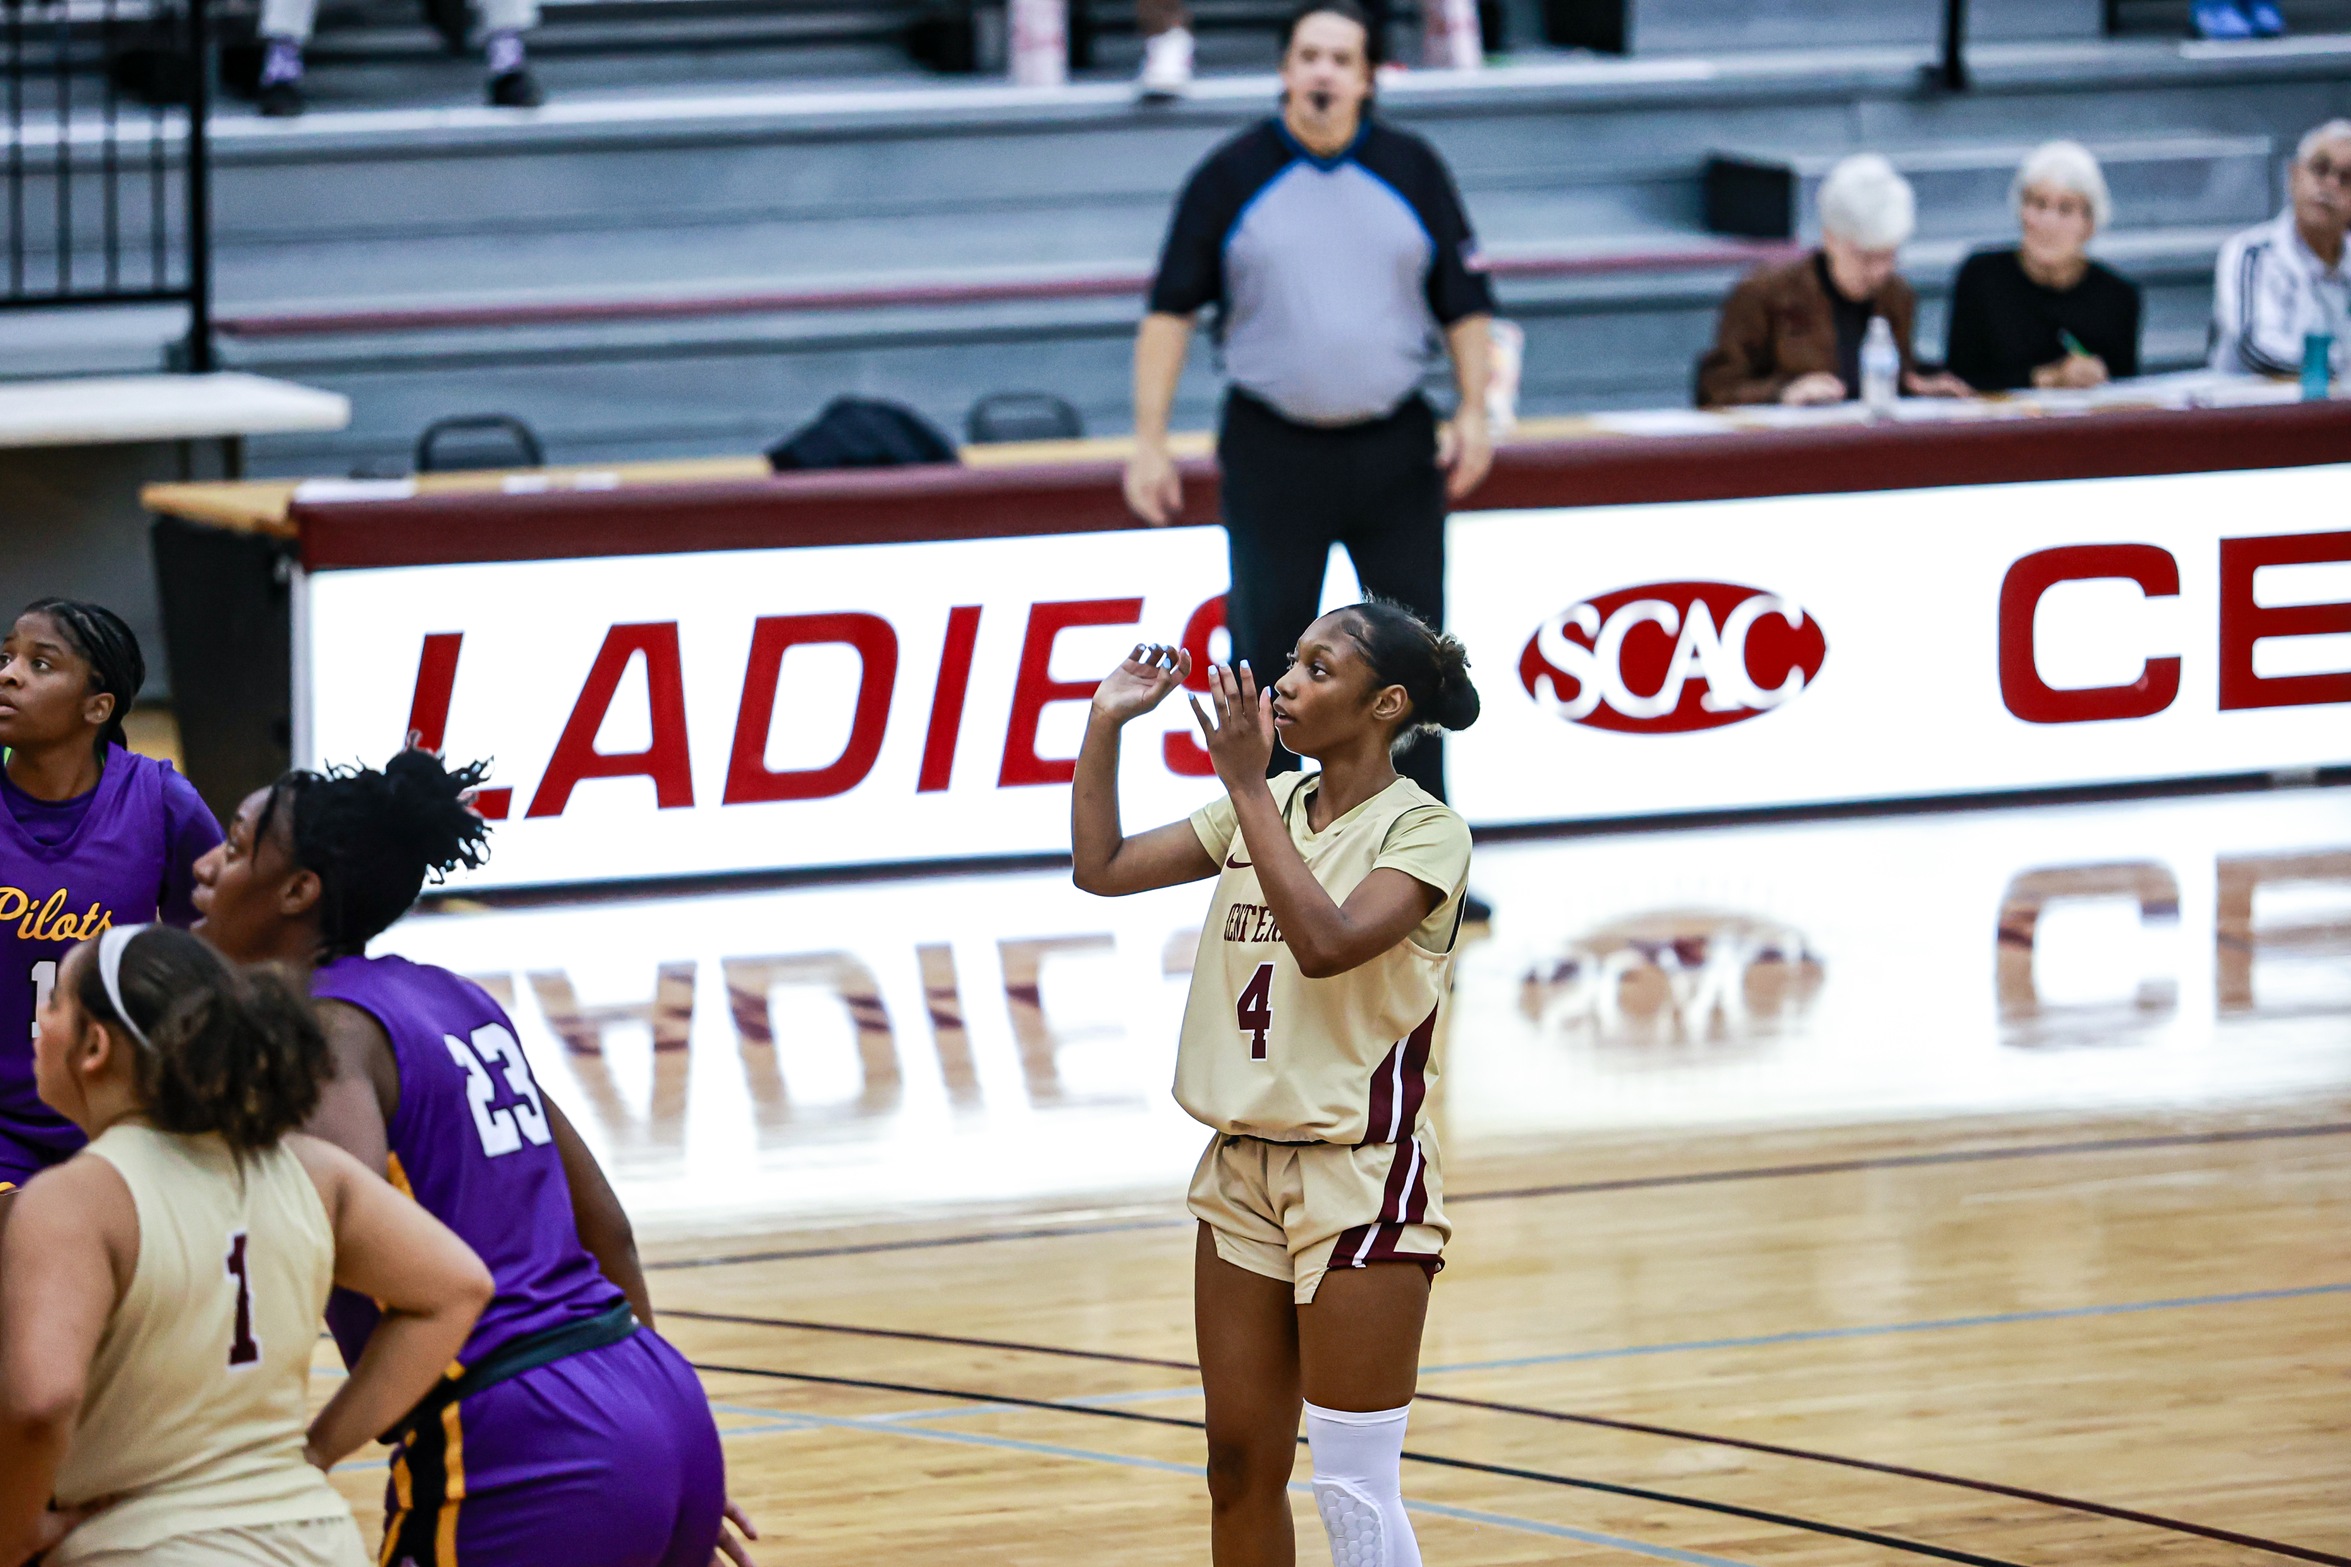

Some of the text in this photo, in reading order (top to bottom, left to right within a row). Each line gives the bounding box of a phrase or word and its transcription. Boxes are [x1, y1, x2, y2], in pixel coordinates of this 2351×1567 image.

[1534, 592, 1806, 721] SCAC
[1998, 530, 2351, 724] CE
[0, 886, 113, 942] Pilots
[1235, 960, 1277, 1062] 4
[443, 1021, 553, 1158] 23
[224, 1231, 263, 1373] 1
